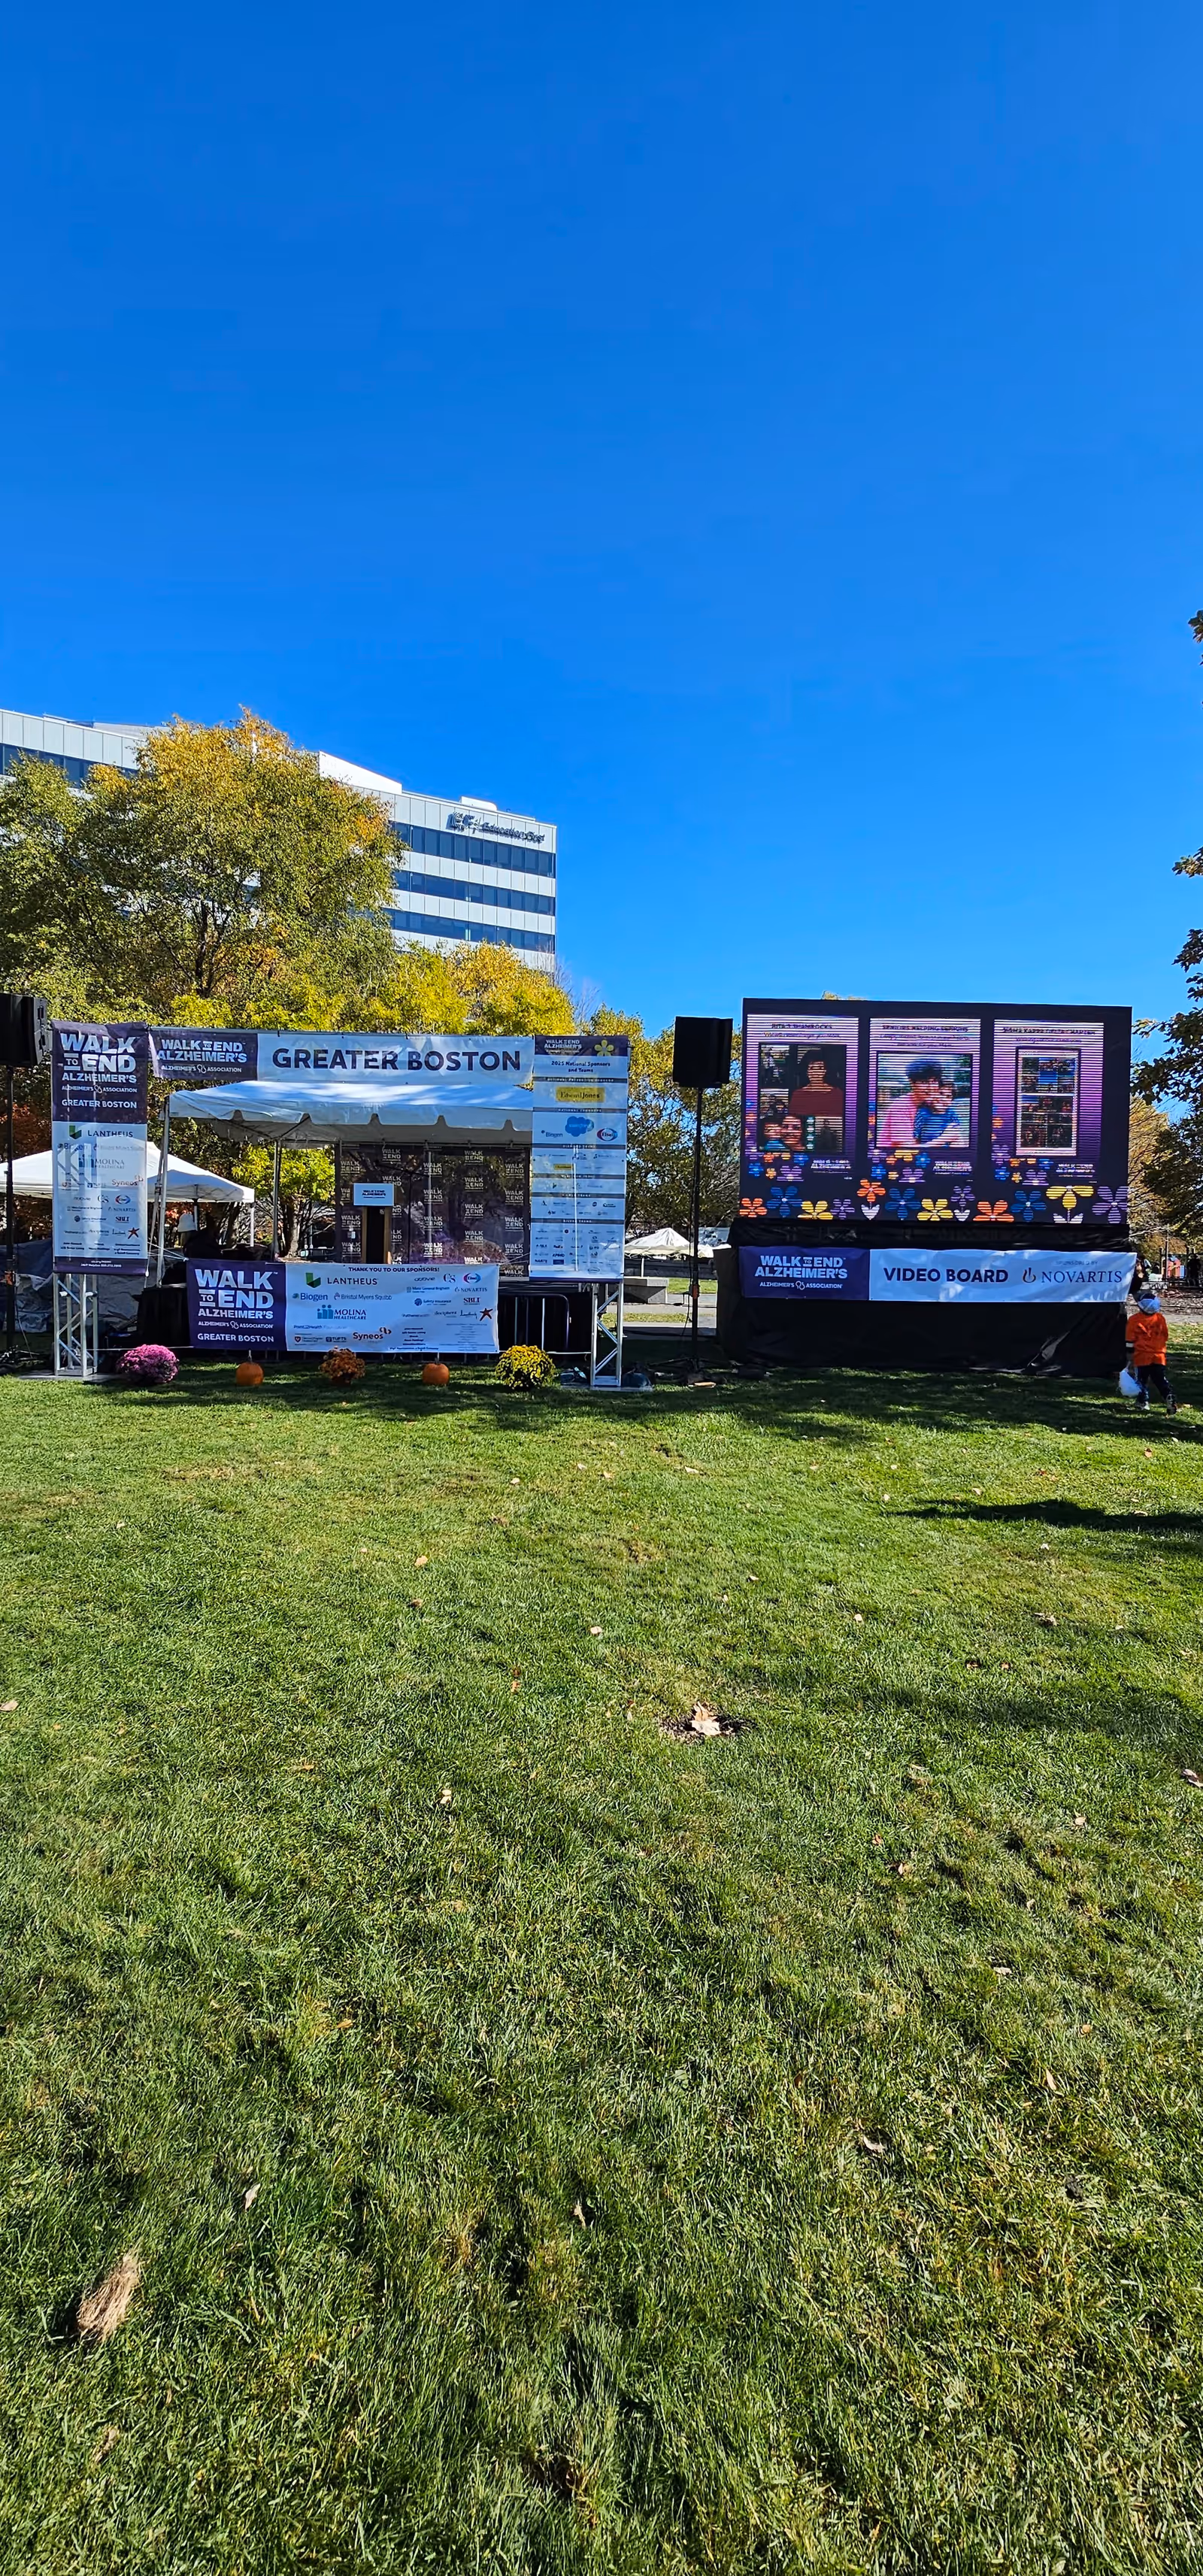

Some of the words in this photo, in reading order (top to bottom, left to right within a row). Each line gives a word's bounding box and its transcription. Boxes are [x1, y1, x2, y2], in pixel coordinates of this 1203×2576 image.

[60, 1033, 136, 1053] WALK
[162, 1039, 201, 1050] WALK
[214, 1041, 242, 1051] END
[157, 1050, 247, 1062] ALZHEIMER'S
[272, 1048, 398, 1070] GREATER
[408, 1051, 520, 1071] BOSTON
[82, 1054, 136, 1072] END
[62, 1073, 137, 1083] ALZHEIMER'S
[760, 1256, 801, 1266] WALK
[814, 1257, 843, 1267] END
[755, 1267, 847, 1278] ALZHEIMER'S
[883, 1268, 941, 1281] VIDEO
[946, 1268, 1009, 1283] BOARD
[1041, 1271, 1122, 1283] NOVARTIS
[195, 1269, 273, 1290] WALK
[218, 1290, 274, 1308] END
[301, 1293, 328, 1302] Biogen
[198, 1308, 273, 1319] ALZHEIMER'S
[353, 1332, 383, 1341] Syneos
